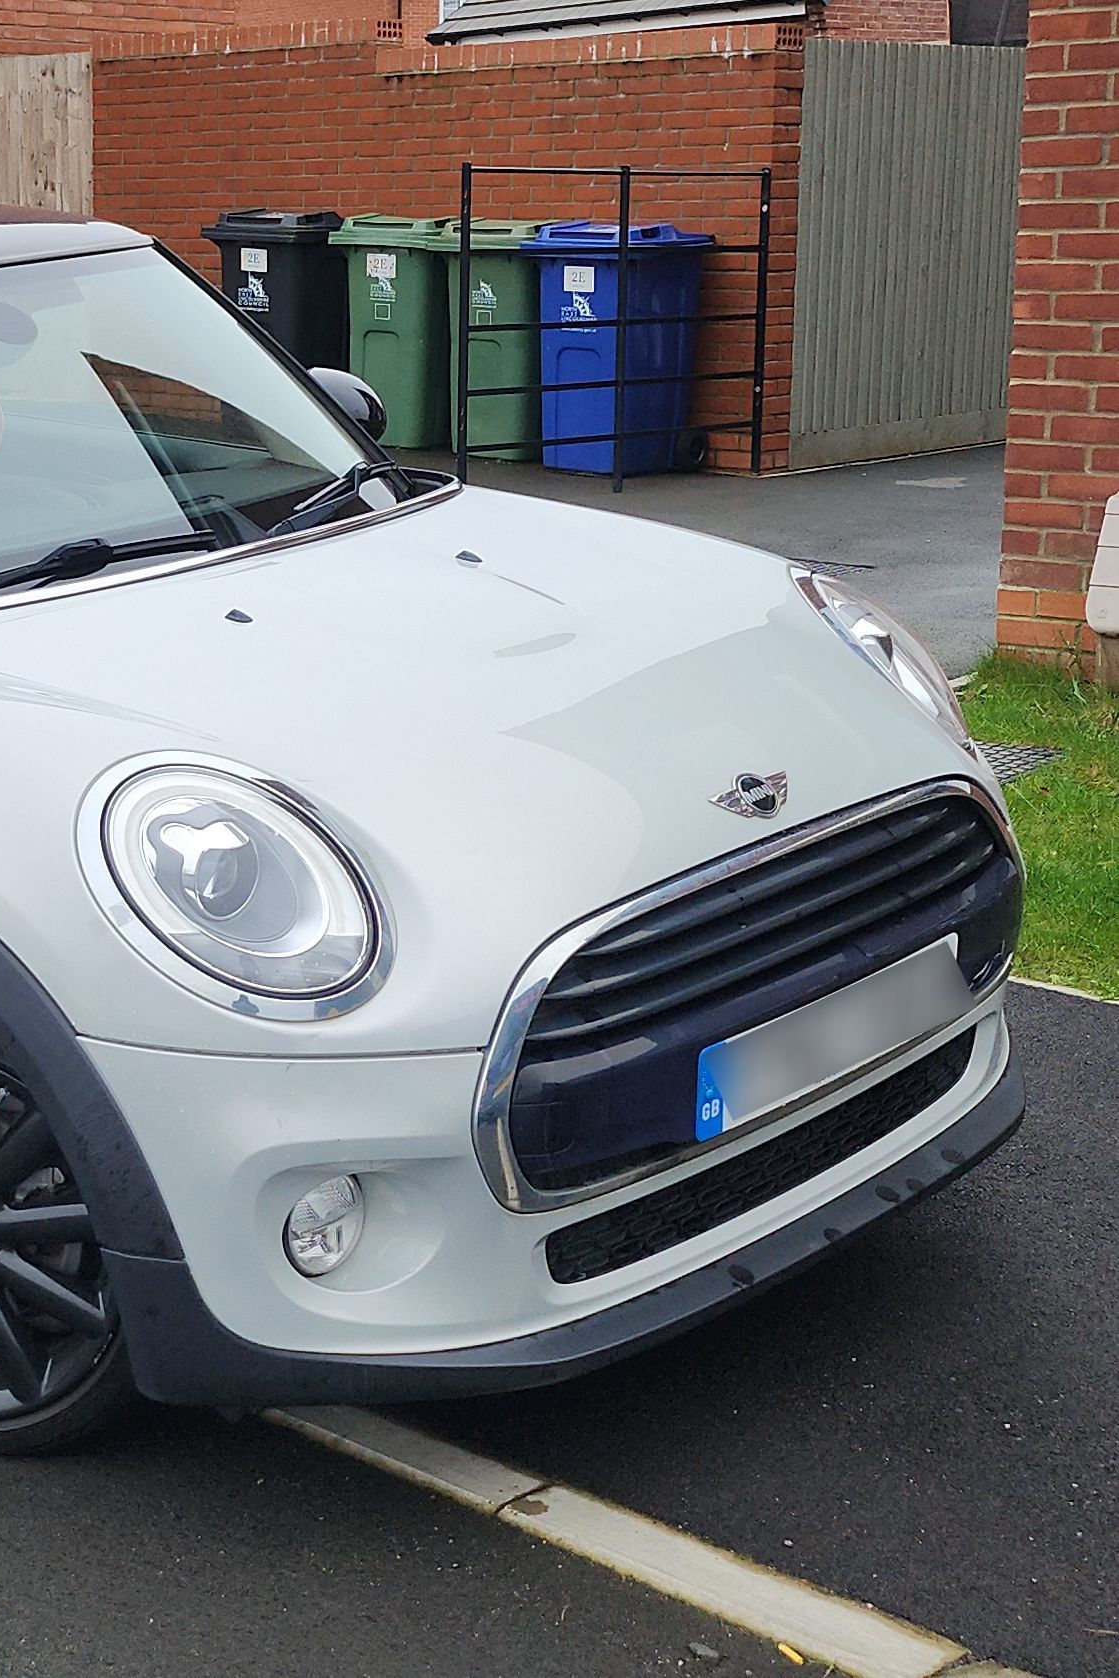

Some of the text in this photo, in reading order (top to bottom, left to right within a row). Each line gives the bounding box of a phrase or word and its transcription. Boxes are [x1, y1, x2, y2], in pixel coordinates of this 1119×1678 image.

[247, 252, 260, 264] 2E
[572, 271, 586, 283] 2E
[702, 1098, 720, 1121] GB
